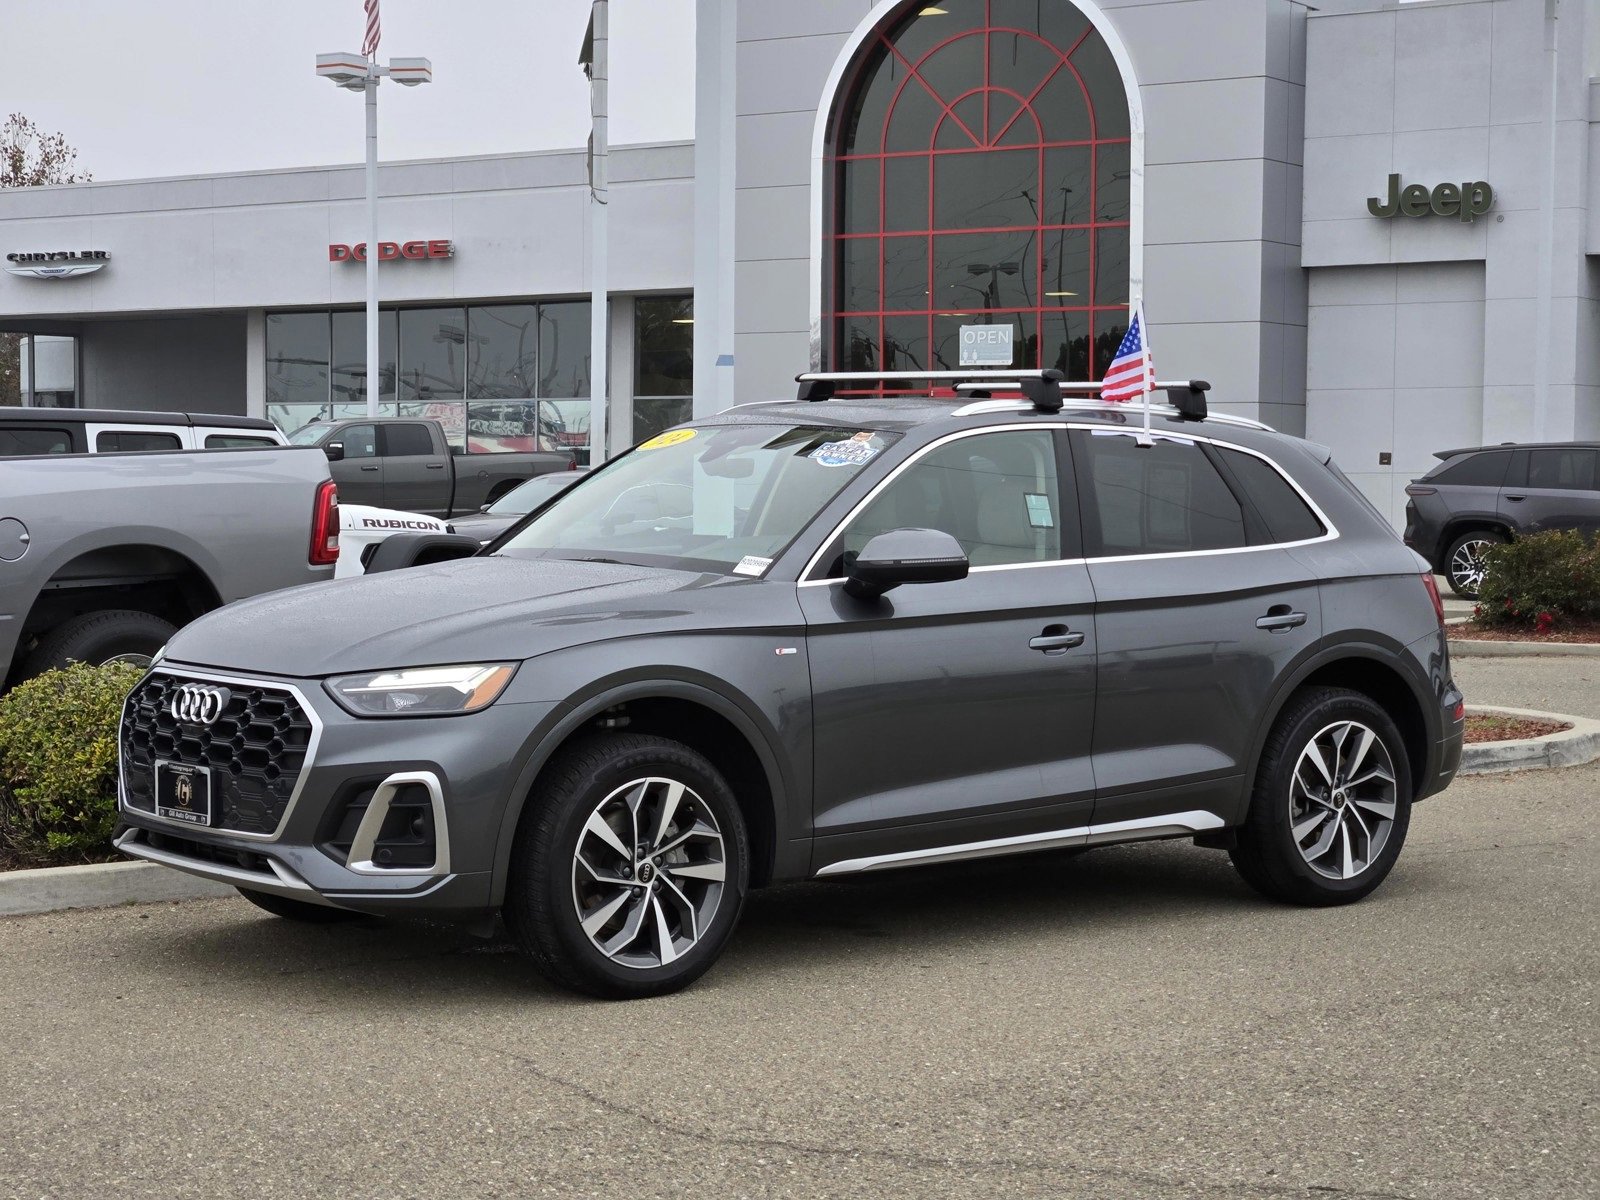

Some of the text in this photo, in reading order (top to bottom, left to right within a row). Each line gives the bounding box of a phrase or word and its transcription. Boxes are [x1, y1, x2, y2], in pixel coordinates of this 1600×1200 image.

[1367, 173, 1493, 223] Jeep
[6, 250, 107, 262] CHRYSLER
[964, 330, 1009, 344] OPEN
[822, 445, 869, 456] CARFAX
[823, 451, 864, 462] OWNER
[362, 518, 440, 530] RUBICON
[176, 811, 184, 819] Auto
[185, 813, 197, 821] Group
